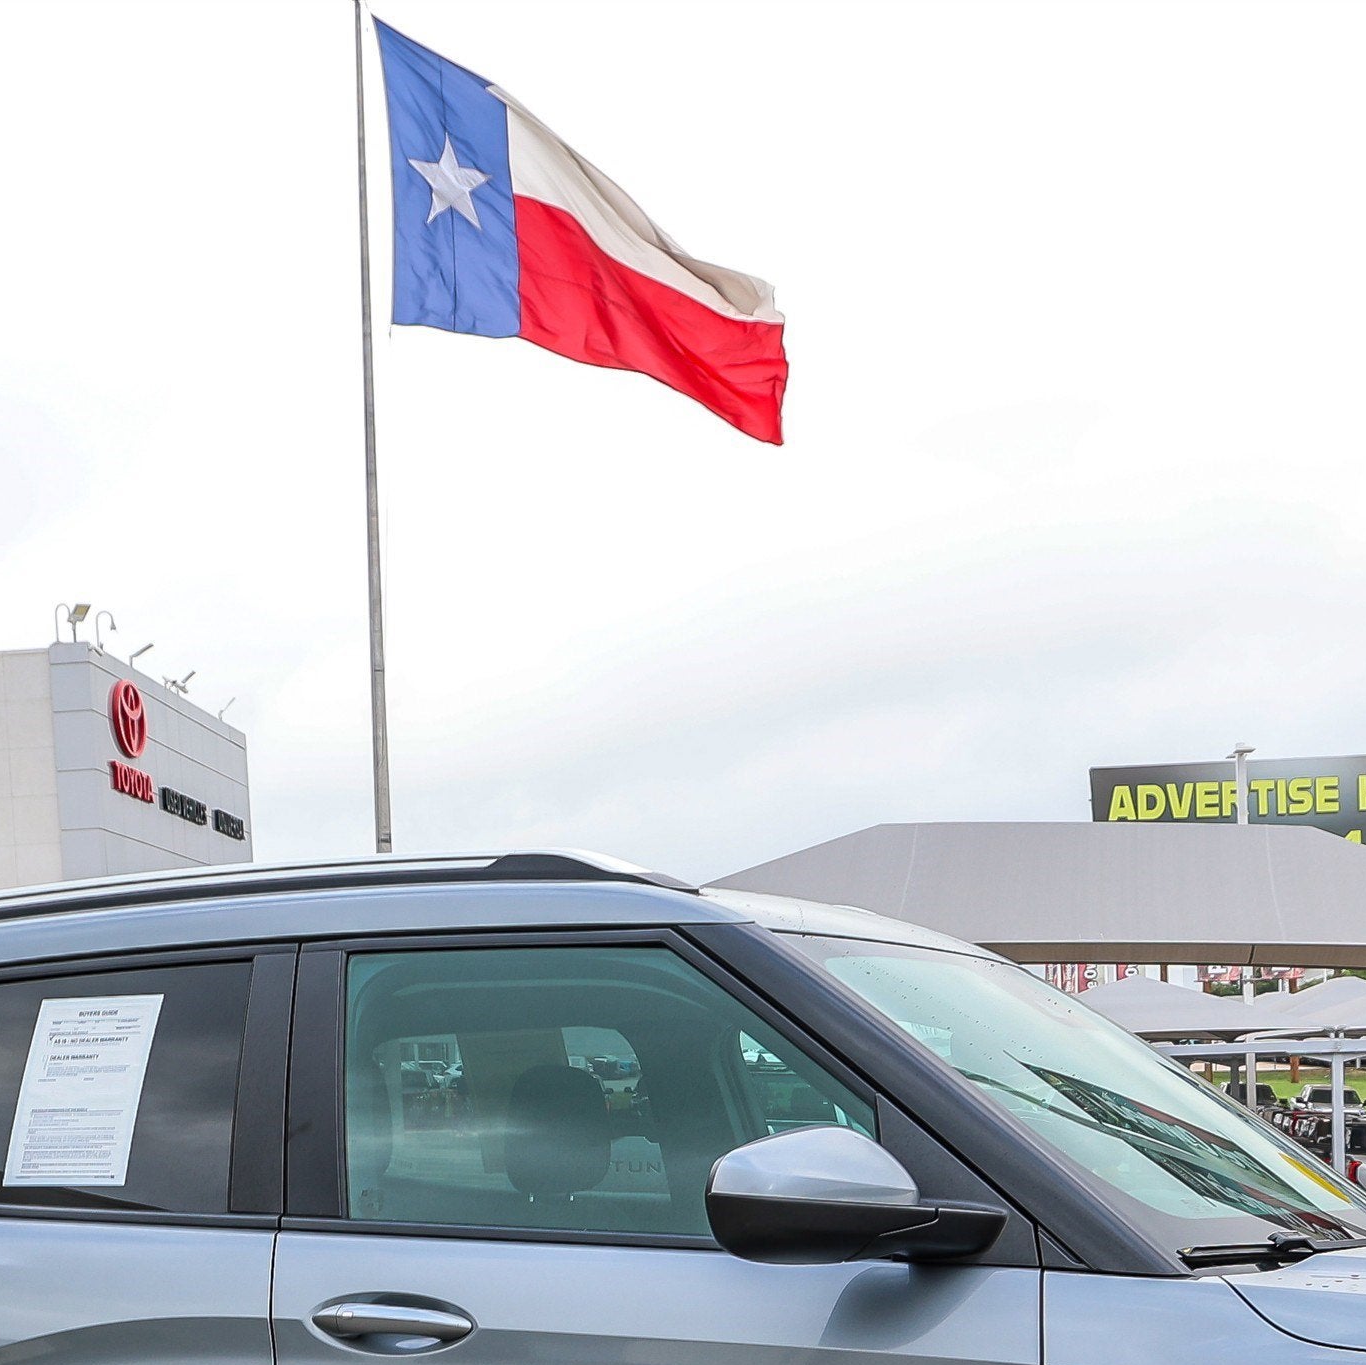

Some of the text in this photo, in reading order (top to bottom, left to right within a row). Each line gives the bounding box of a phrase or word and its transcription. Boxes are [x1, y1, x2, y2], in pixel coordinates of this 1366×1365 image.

[111, 760, 155, 804] TOYOTA
[1108, 776, 1340, 821] ADVERTISE
[101, 1009, 119, 1017] GUIDE
